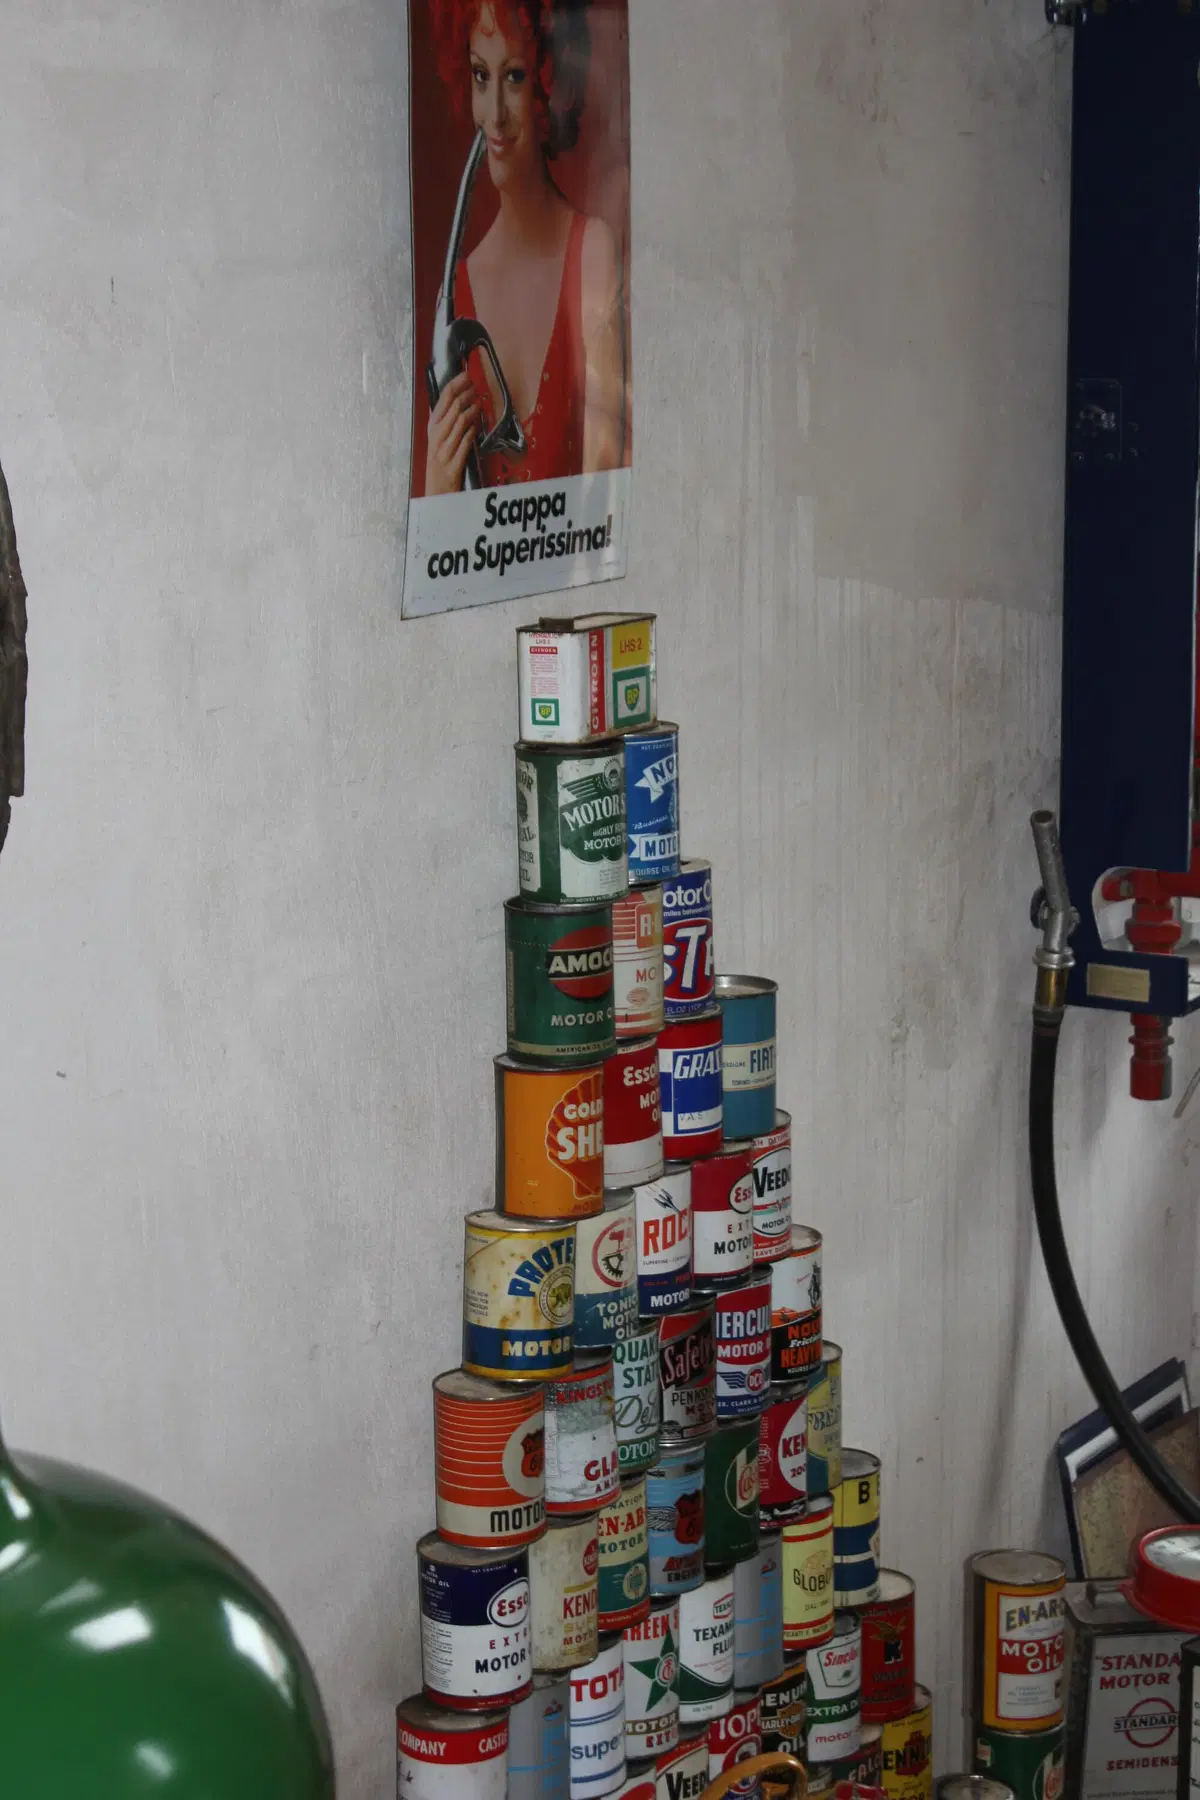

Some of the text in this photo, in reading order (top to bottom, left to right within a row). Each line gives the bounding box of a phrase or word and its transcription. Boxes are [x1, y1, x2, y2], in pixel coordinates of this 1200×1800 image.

[484, 491, 566, 532] Scappa
[427, 514, 613, 579] con Superissima!
[619, 637, 643, 655] LHS 2
[626, 685, 639, 705] BP
[540, 706, 551, 717] BP
[584, 834, 621, 851] MOTOR
[663, 884, 702, 908] otor
[663, 909, 681, 918] miles
[551, 1009, 604, 1028] MOTOR
[750, 1044, 774, 1074] FIAT
[650, 1288, 690, 1309] MOTOR
[502, 1335, 571, 1357] MOTOR
[716, 1341, 764, 1359] MOTOR
[617, 1436, 656, 1461] OTOR
[475, 1647, 526, 1673] MOTOR
[1026, 1656, 1060, 1673] OIL
[1099, 1672, 1170, 1690] MOTOR
[1113, 1713, 1178, 1731] STANDAR
